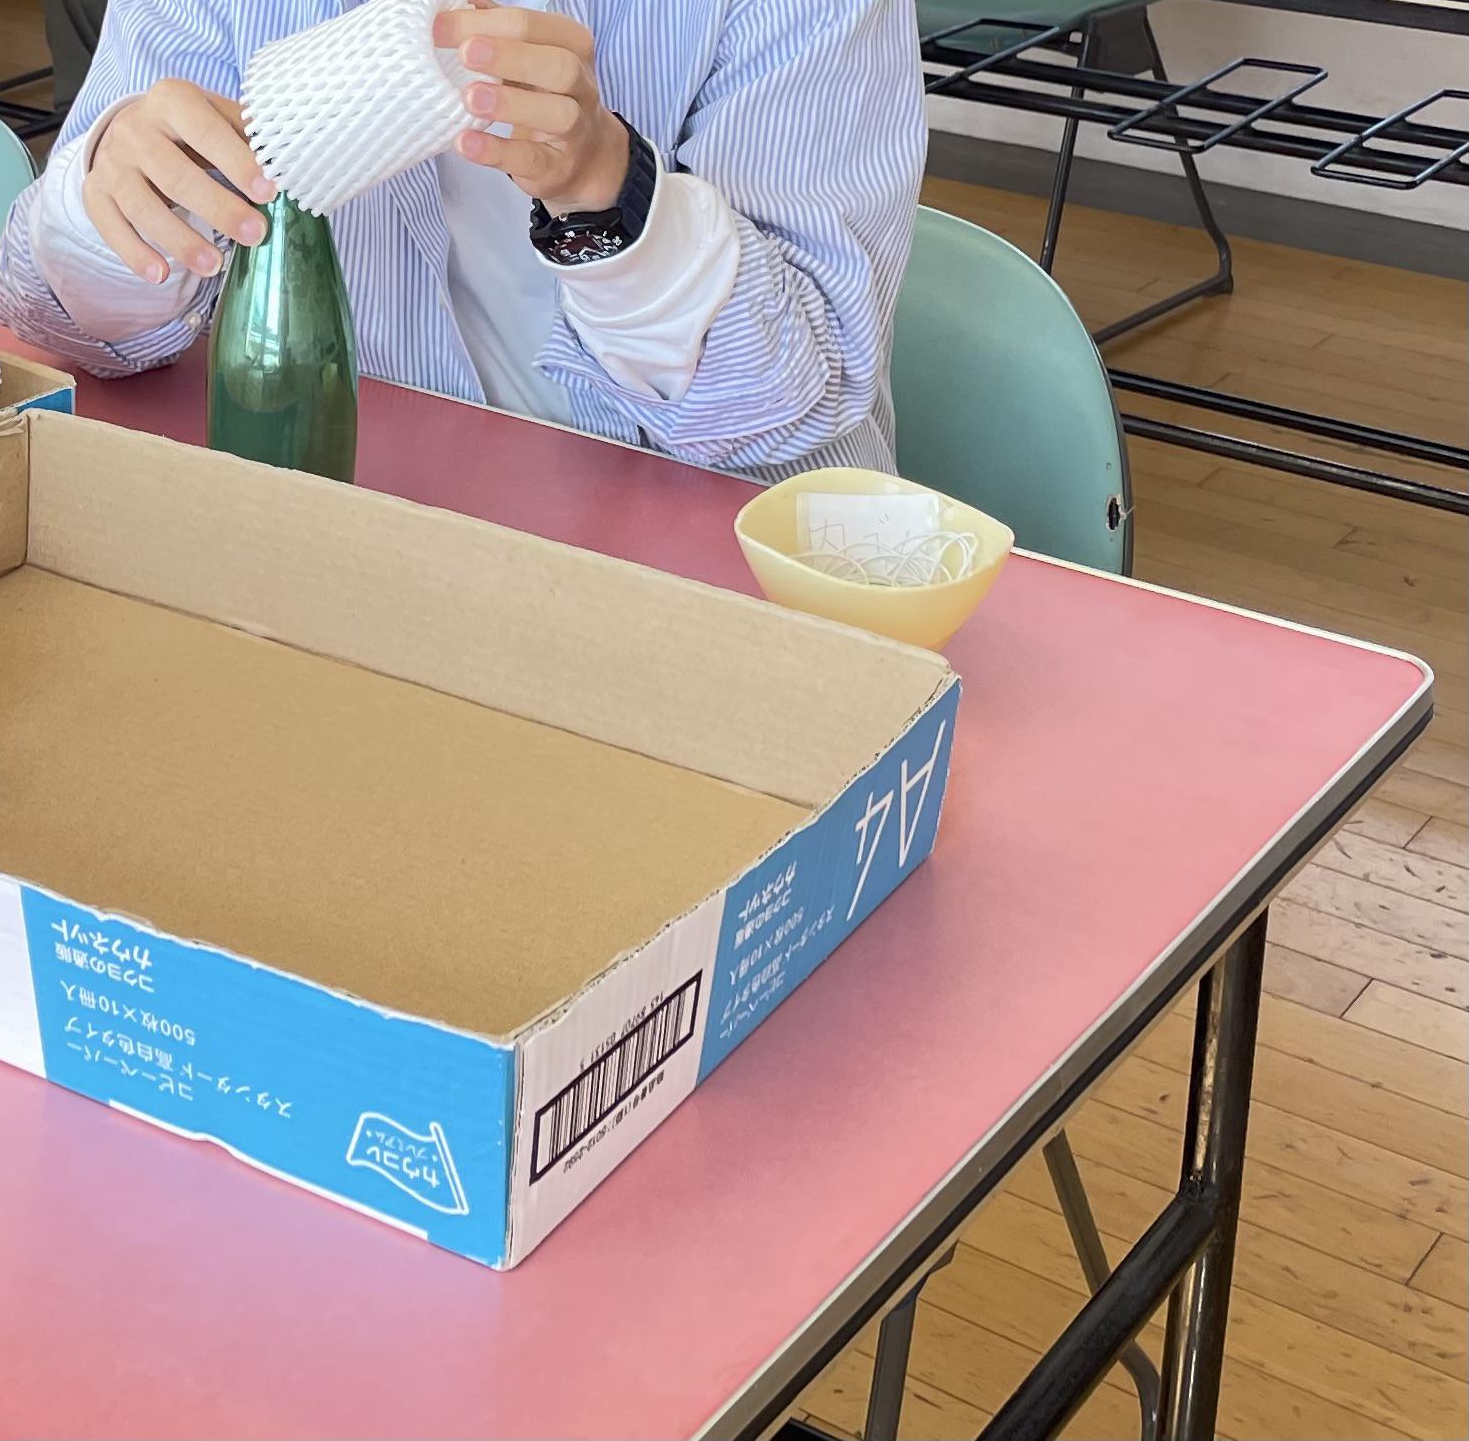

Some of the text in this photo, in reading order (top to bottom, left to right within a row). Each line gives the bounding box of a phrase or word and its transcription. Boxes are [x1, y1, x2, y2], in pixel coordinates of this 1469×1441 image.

[846, 719, 946, 922] A4
[733, 887, 792, 950] コクヨの通販
[738, 860, 797, 922] カウネット
[50, 918, 153, 969] カウネット
[54, 941, 155, 994] コクヨの通販
[719, 970, 786, 1039] コピーペーパー
[64, 1015, 173, 1072] 高白色タイプ
[66, 1041, 195, 1102] コピーペーパー
[366, 1145, 440, 1189] カウコレ
